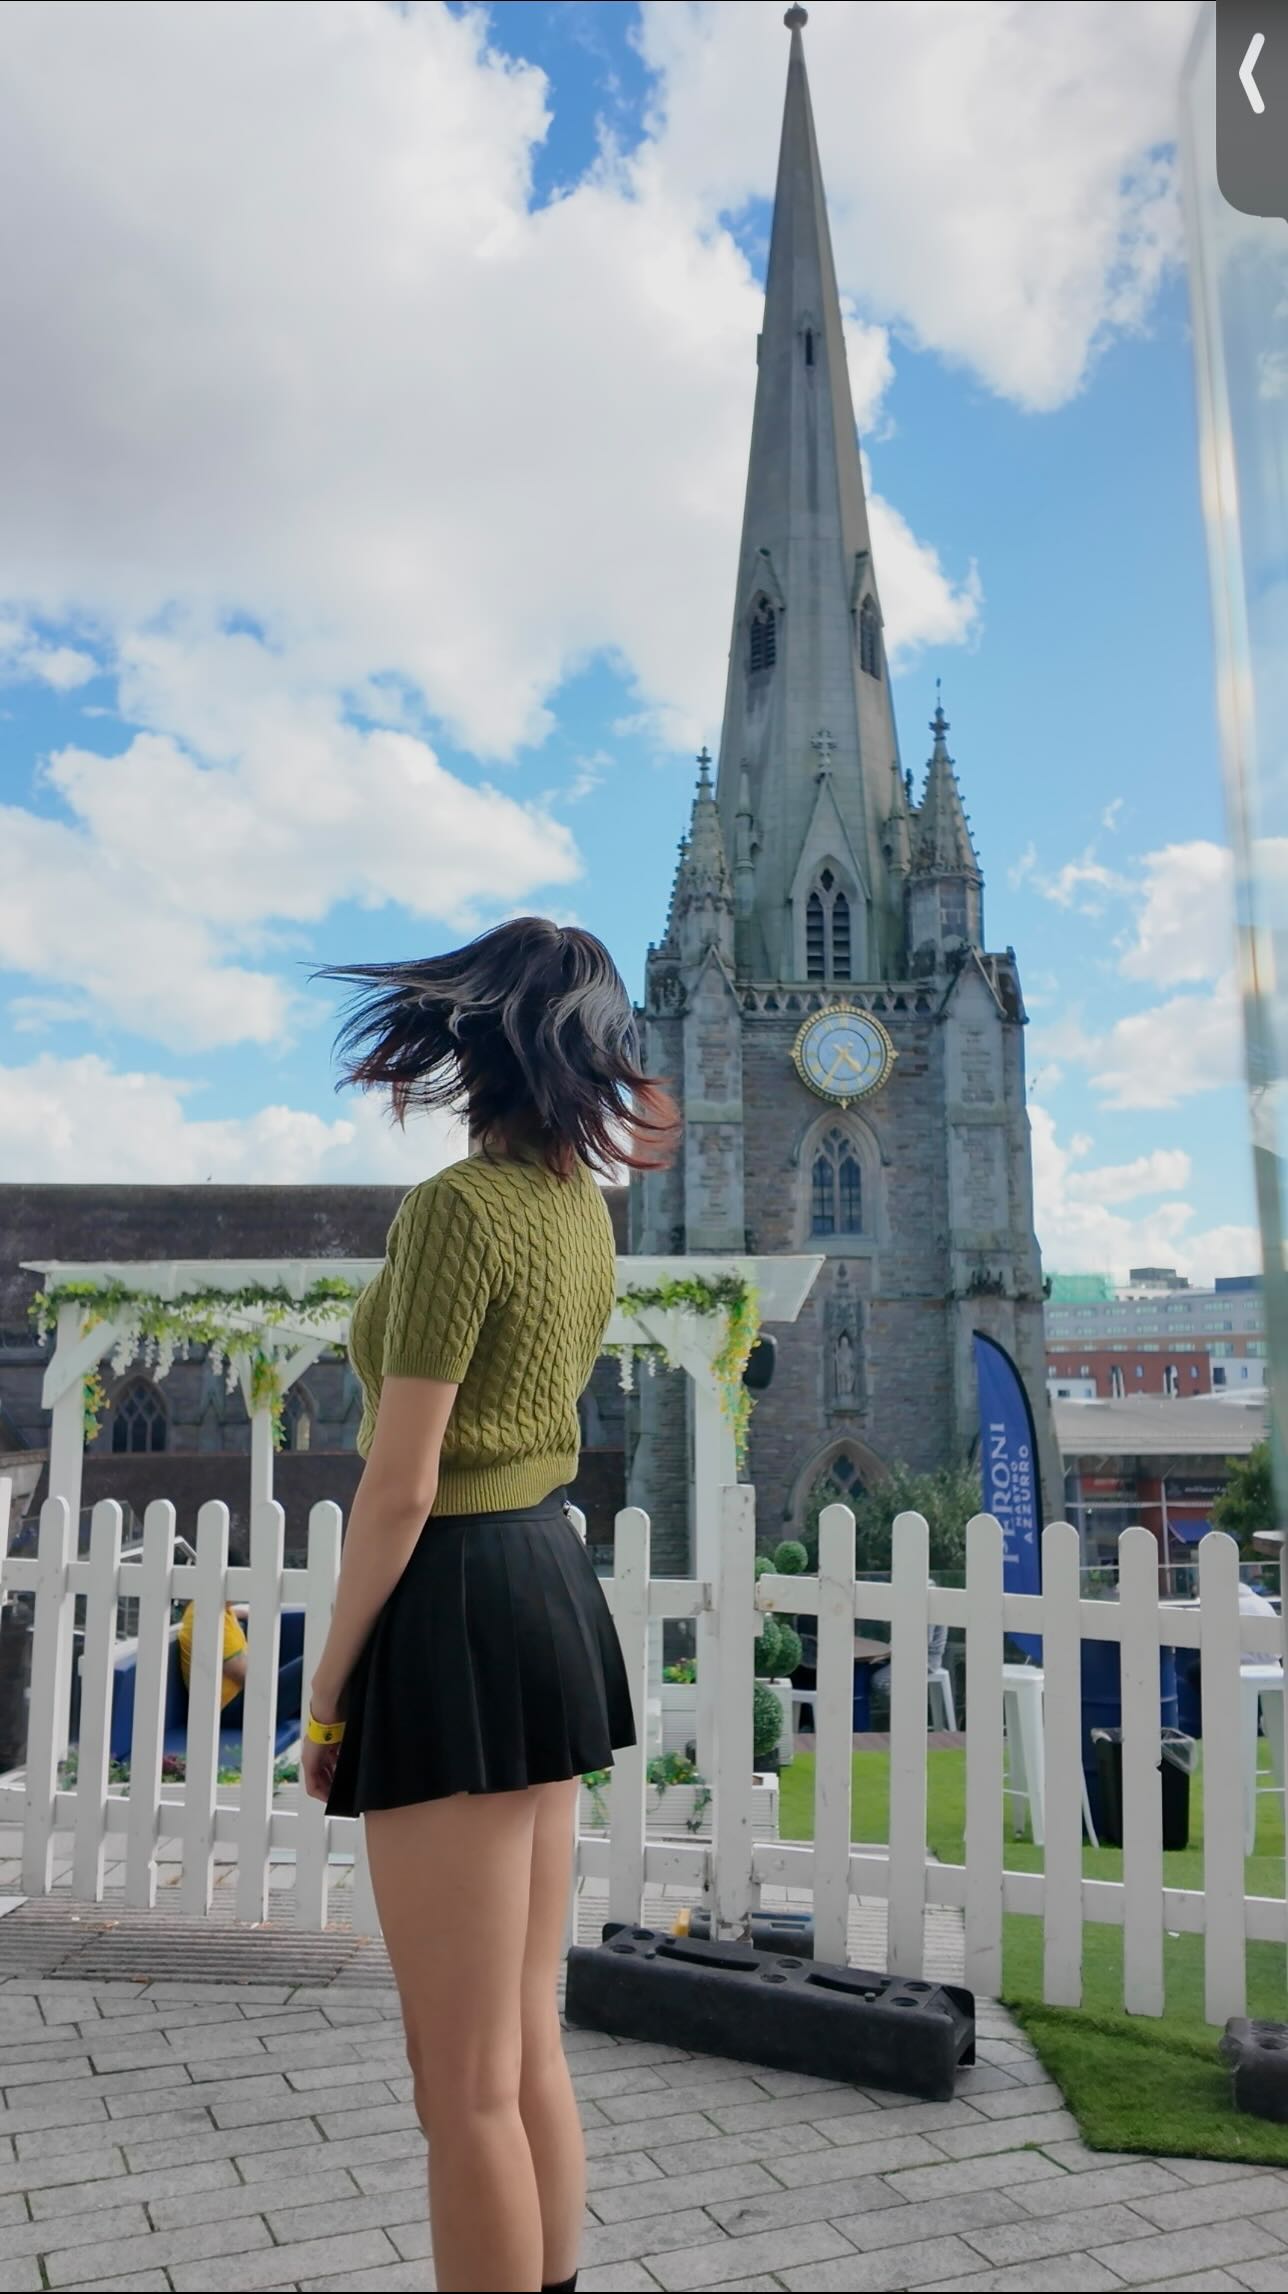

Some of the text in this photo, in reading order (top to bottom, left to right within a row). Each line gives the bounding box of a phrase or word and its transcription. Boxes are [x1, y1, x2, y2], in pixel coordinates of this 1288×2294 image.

[990, 1423, 1020, 1563] PERONI
[1011, 1461, 1023, 1527] NASTRO
[1019, 1445, 1033, 1544] AZZURRO
